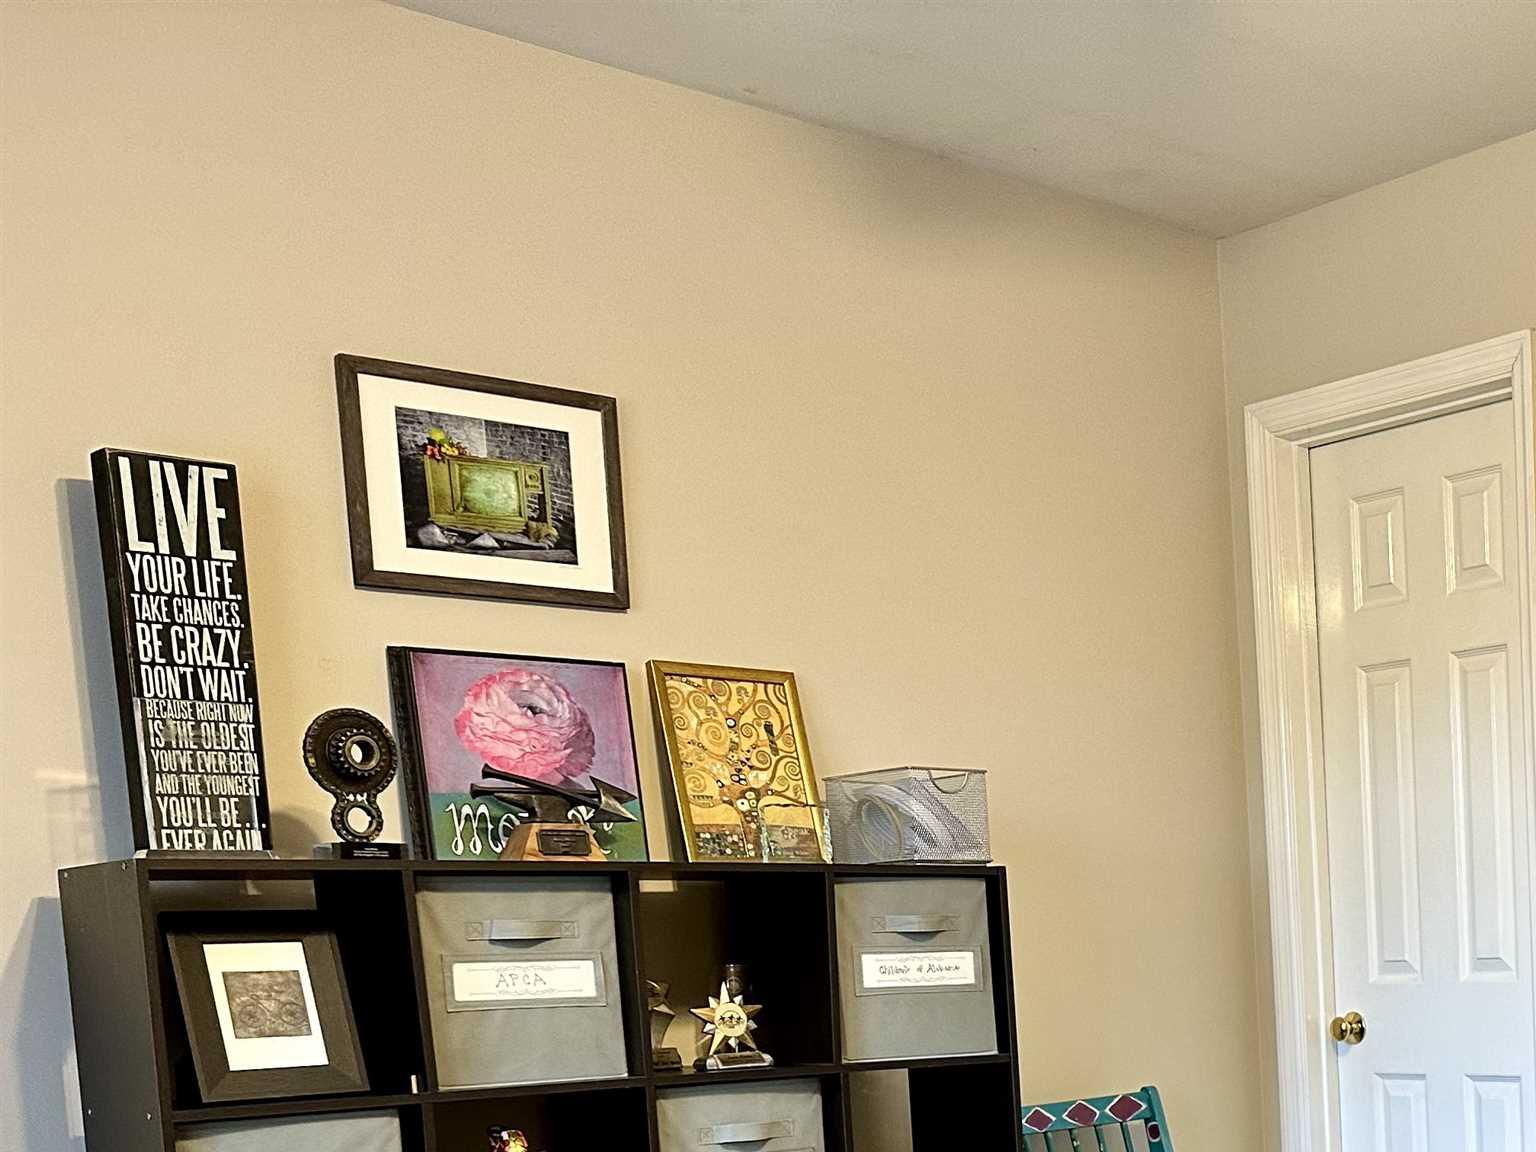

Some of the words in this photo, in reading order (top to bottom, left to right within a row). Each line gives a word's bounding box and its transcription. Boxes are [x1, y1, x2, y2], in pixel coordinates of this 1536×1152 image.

[118, 456, 237, 560] LIVE
[126, 552, 188, 596] YOUR
[191, 558, 242, 600] LIFE.
[131, 593, 171, 622] TAKE
[173, 597, 244, 628] CHANCES.
[136, 622, 166, 663] BE
[170, 625, 249, 669] CRAZY.
[140, 664, 194, 700] DON'T
[198, 668, 253, 703] WAIT.
[145, 699, 195, 720] BECAUSE
[196, 700, 229, 721] RIGHT
[229, 703, 253, 723] NOW
[148, 719, 165, 748] IS
[171, 720, 198, 749] THE
[200, 722, 255, 751] OLDEST
[151, 749, 195, 772] YOU'VE
[196, 750, 227, 773] EVER
[229, 752, 259, 775] BEEN
[155, 773, 179, 794] AND
[180, 774, 203, 795] THE
[204, 774, 260, 796] YOUNGEST
[156, 796, 217, 827] YOU'LL
[160, 829, 206, 850] EVER
[212, 829, 263, 850] AGAIN
[495, 973, 547, 988] APCA
